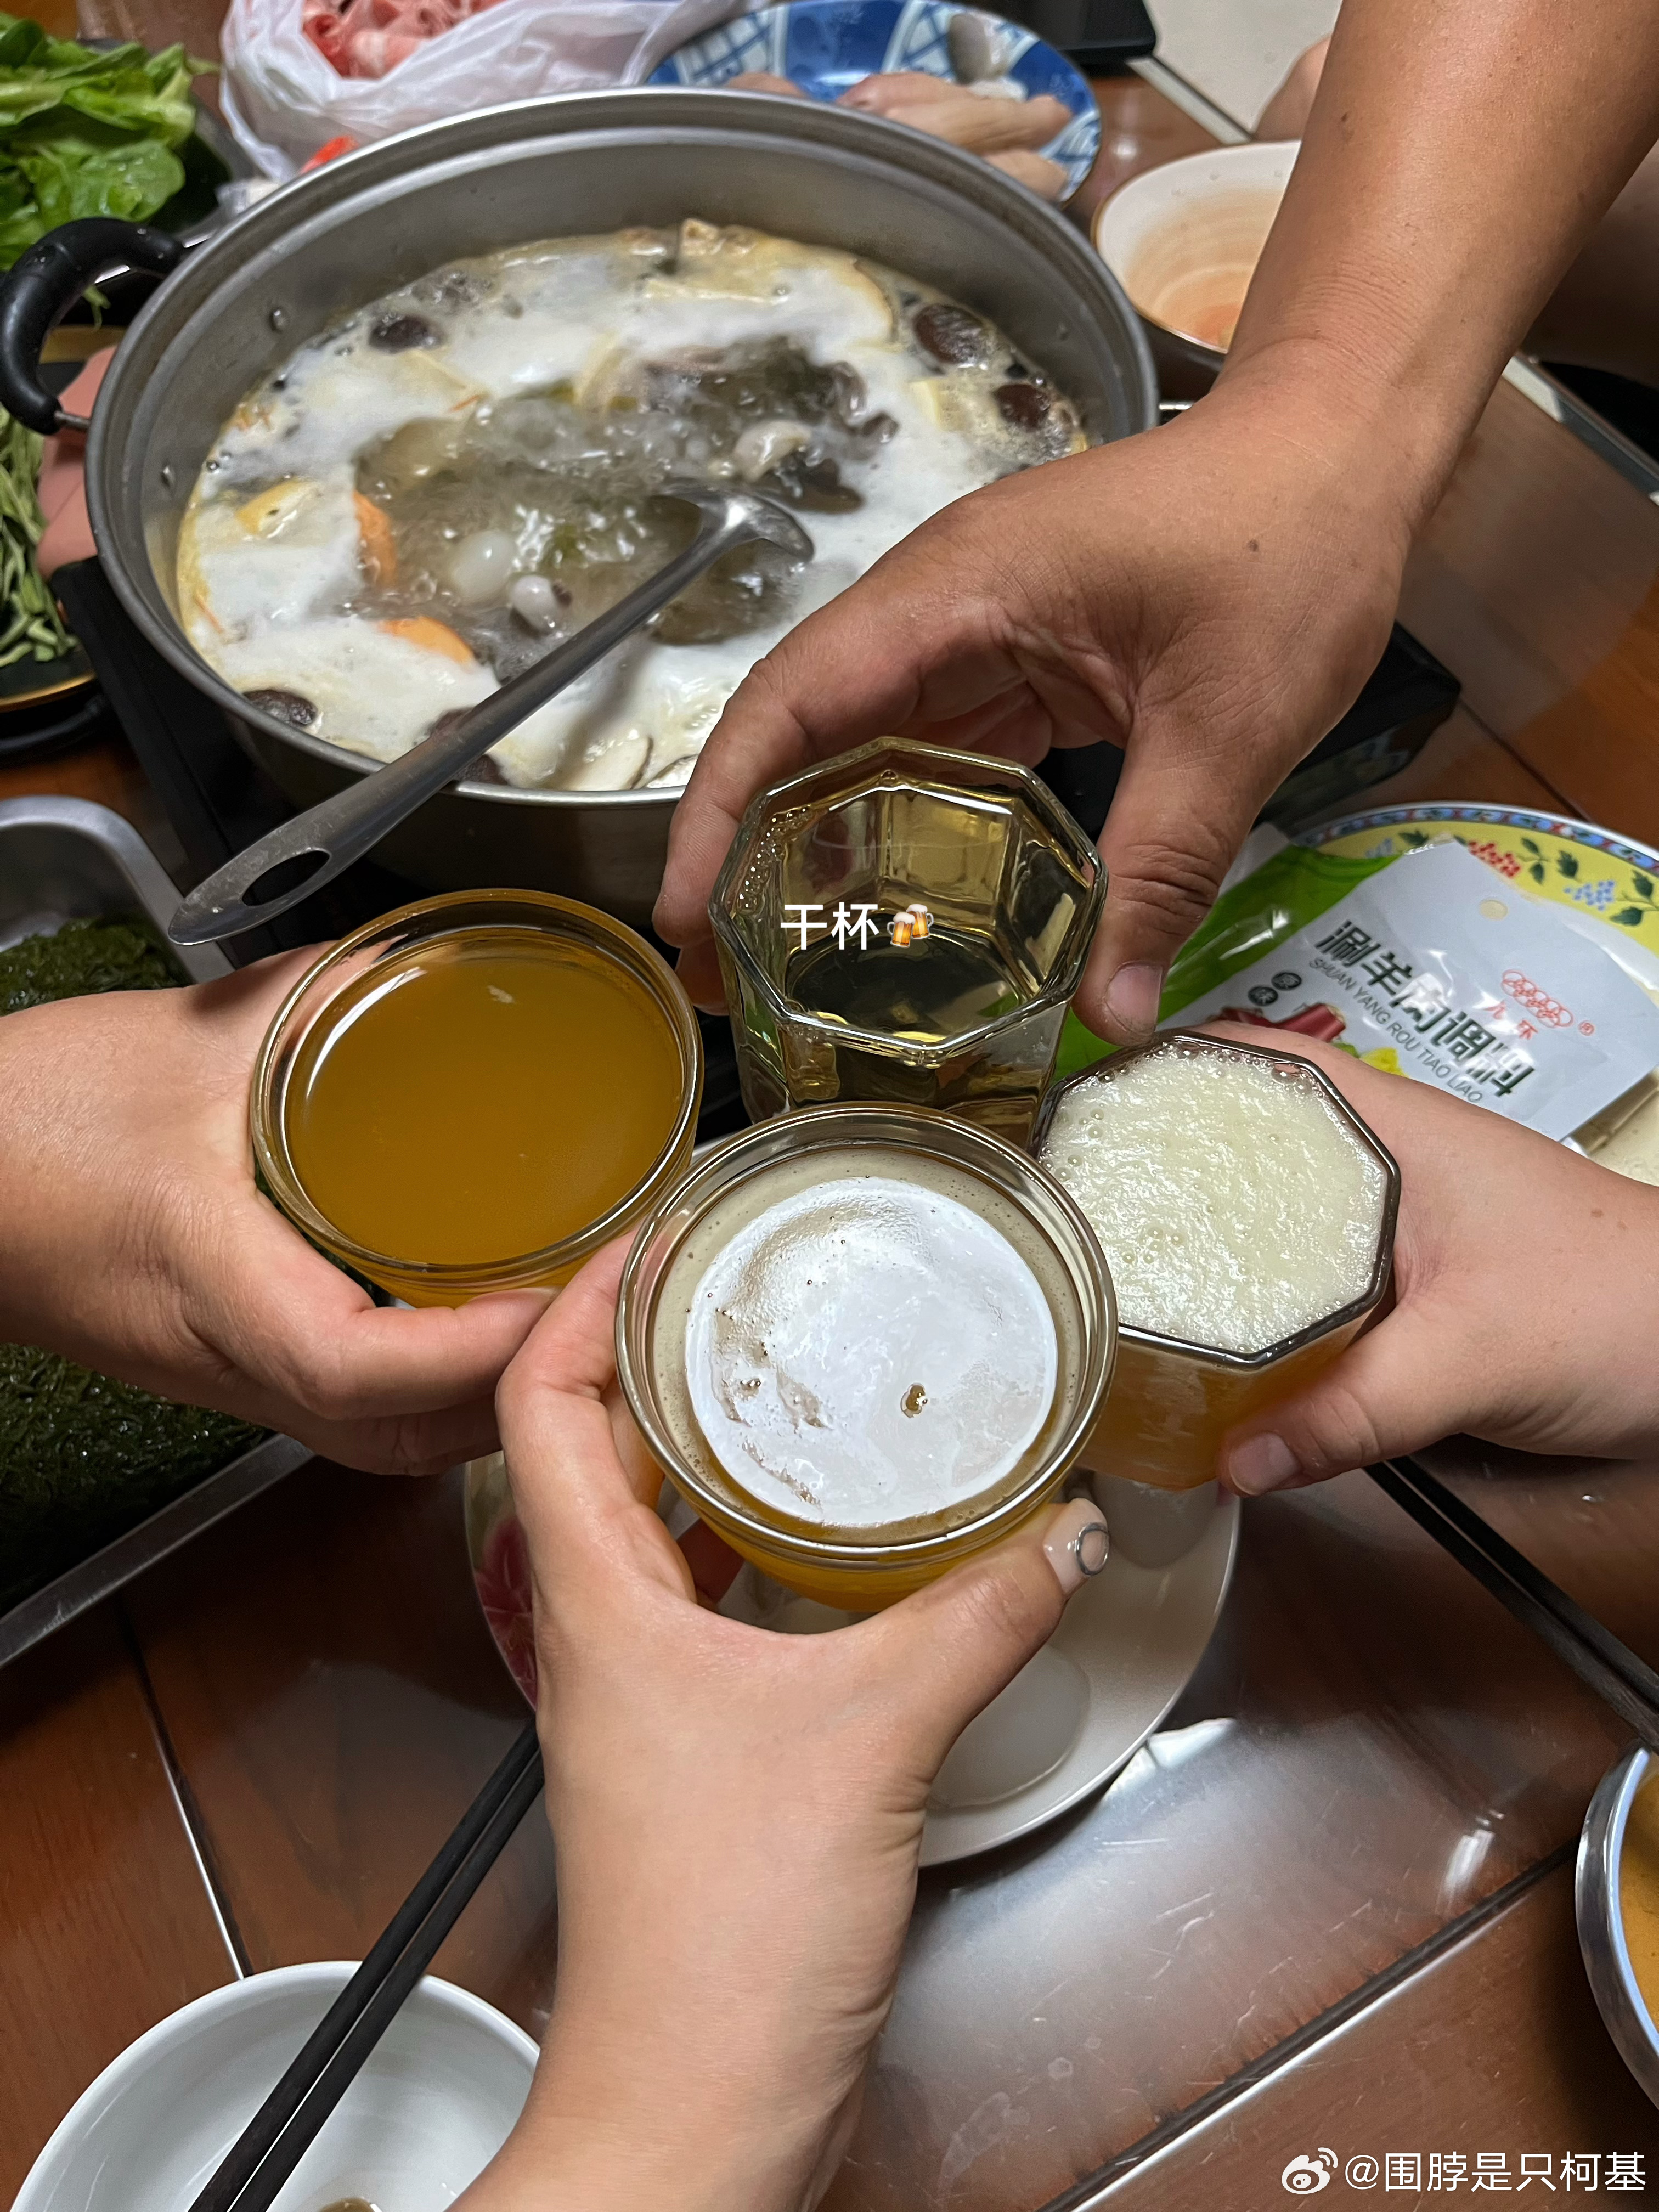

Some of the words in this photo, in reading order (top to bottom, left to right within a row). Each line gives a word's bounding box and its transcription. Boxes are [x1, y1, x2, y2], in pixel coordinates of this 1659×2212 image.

[1308, 957, 1357, 991] SHUAN
[1353, 986, 1391, 1025] YANG
[1386, 1022, 1421, 1052] ROU
[1417, 1048, 1452, 1079] TIAO
[1446, 1073, 1483, 1103] LIAO
